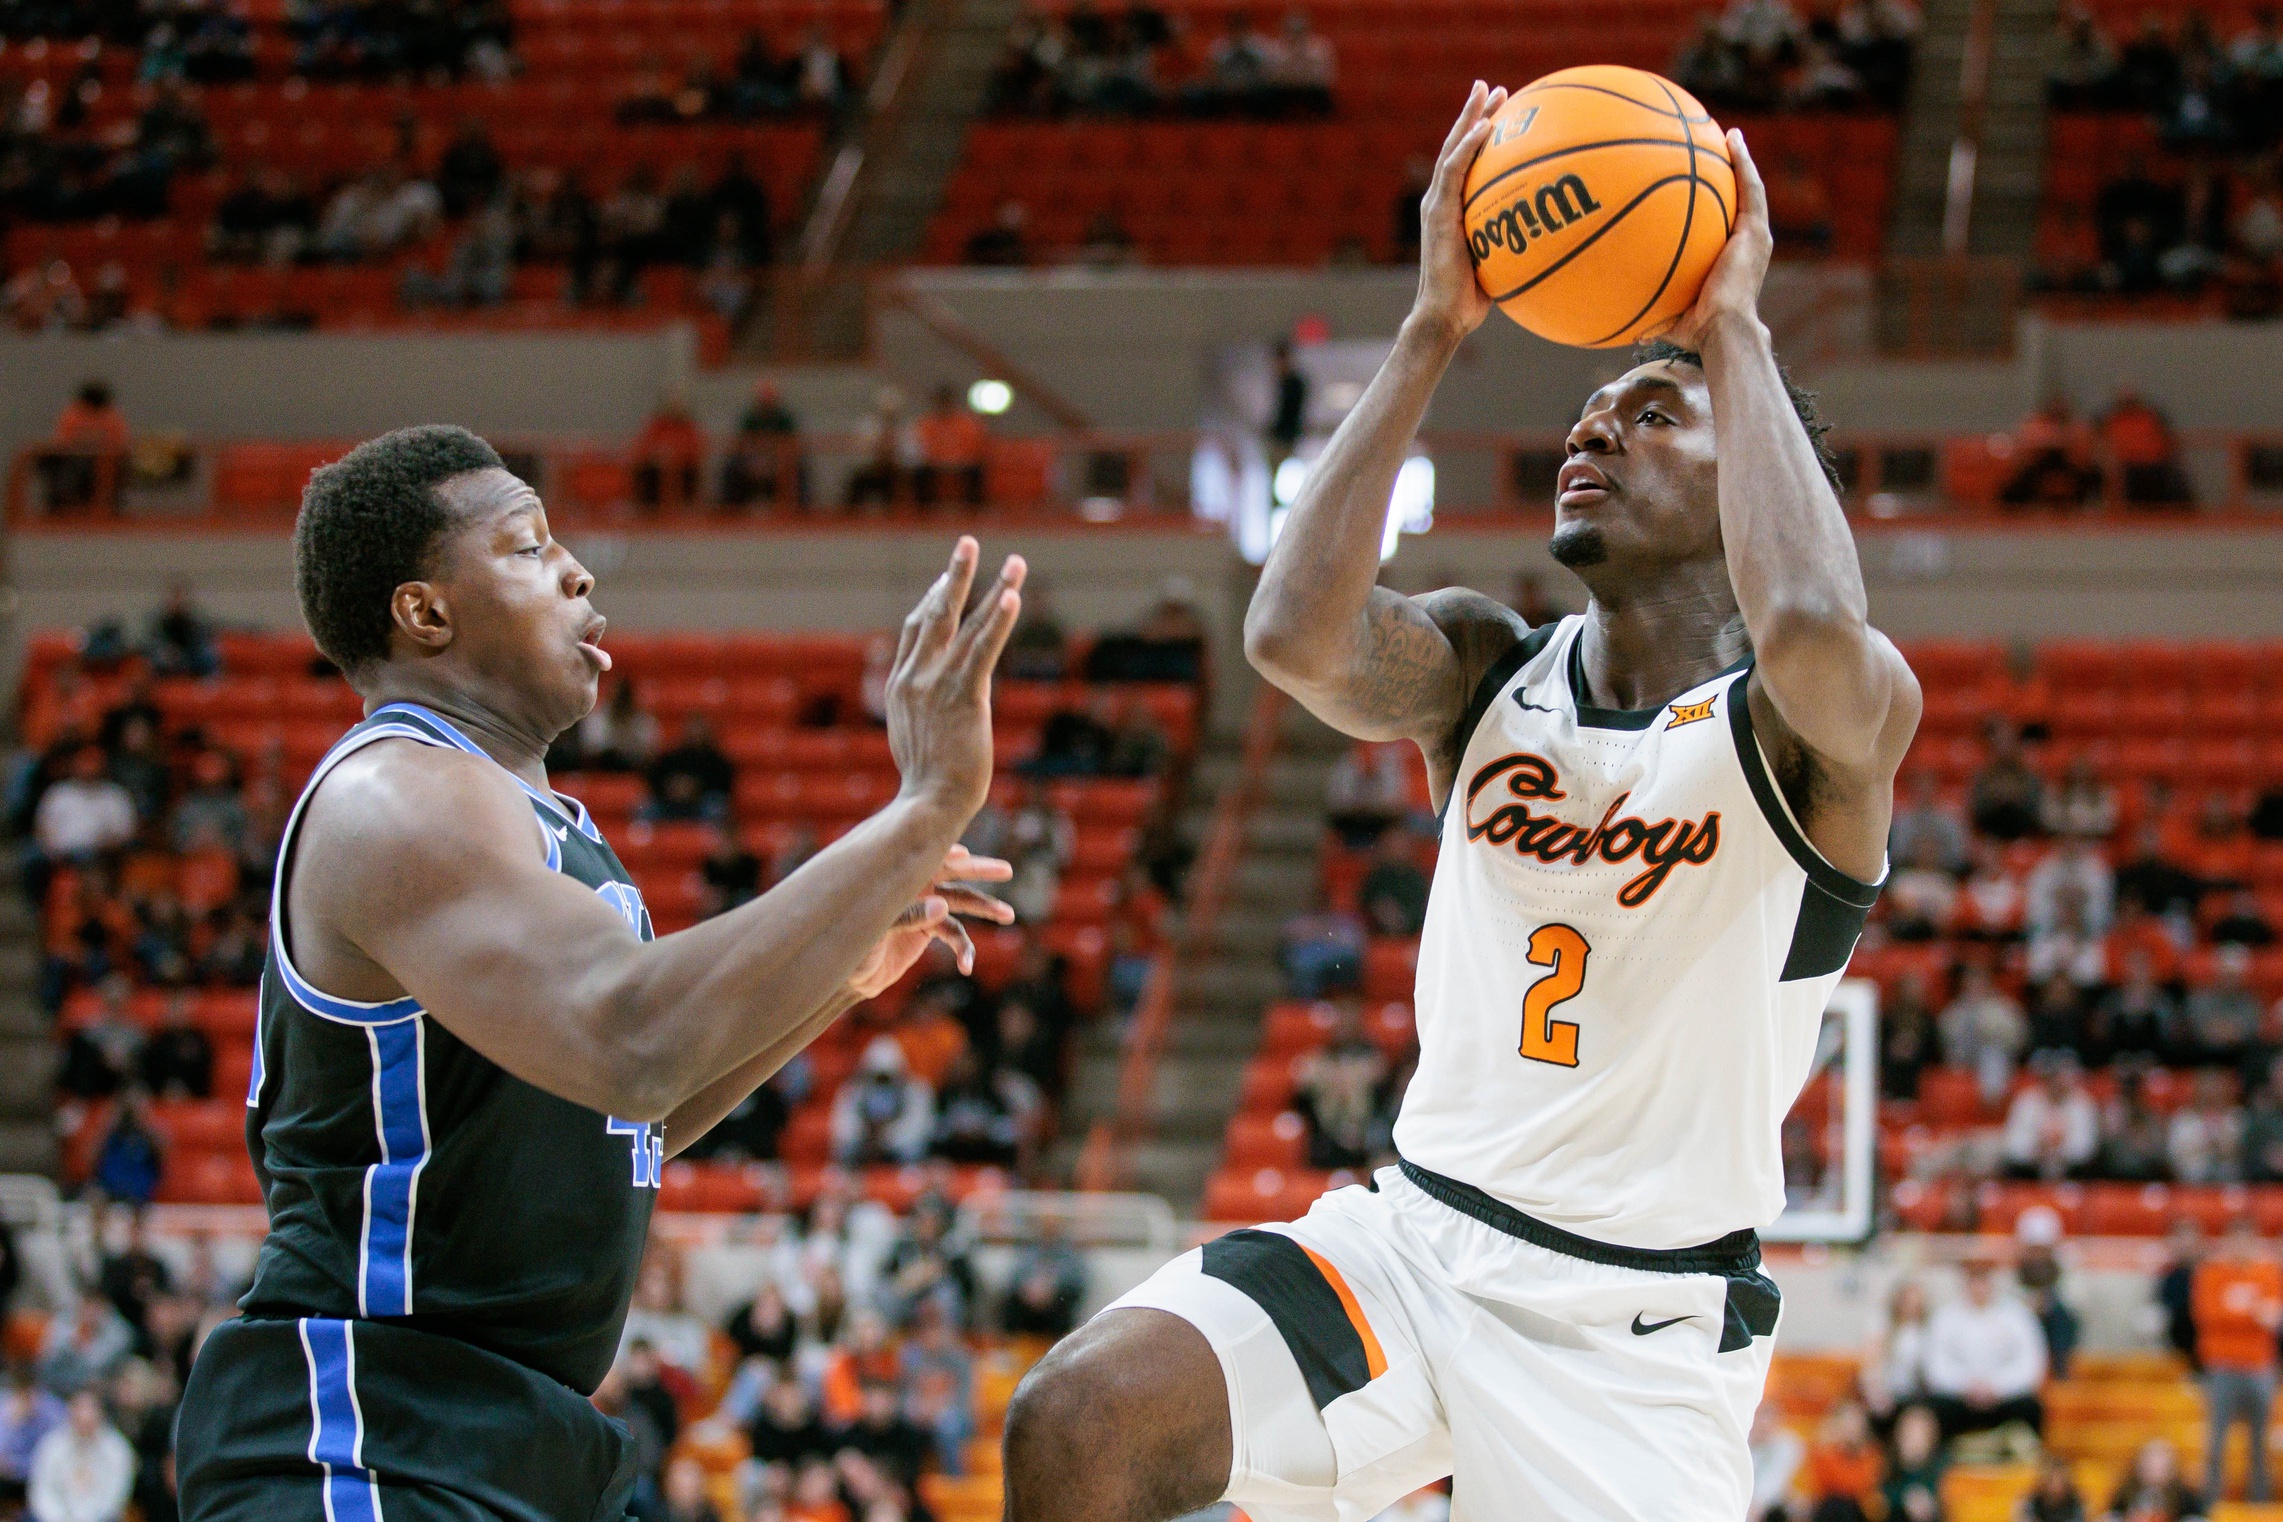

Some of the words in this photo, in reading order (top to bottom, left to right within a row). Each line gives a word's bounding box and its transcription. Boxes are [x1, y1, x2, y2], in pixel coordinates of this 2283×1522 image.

[1664, 693, 1719, 732] XII
[1466, 752, 1720, 909] Cowboys
[1518, 923, 1591, 1068] 2
